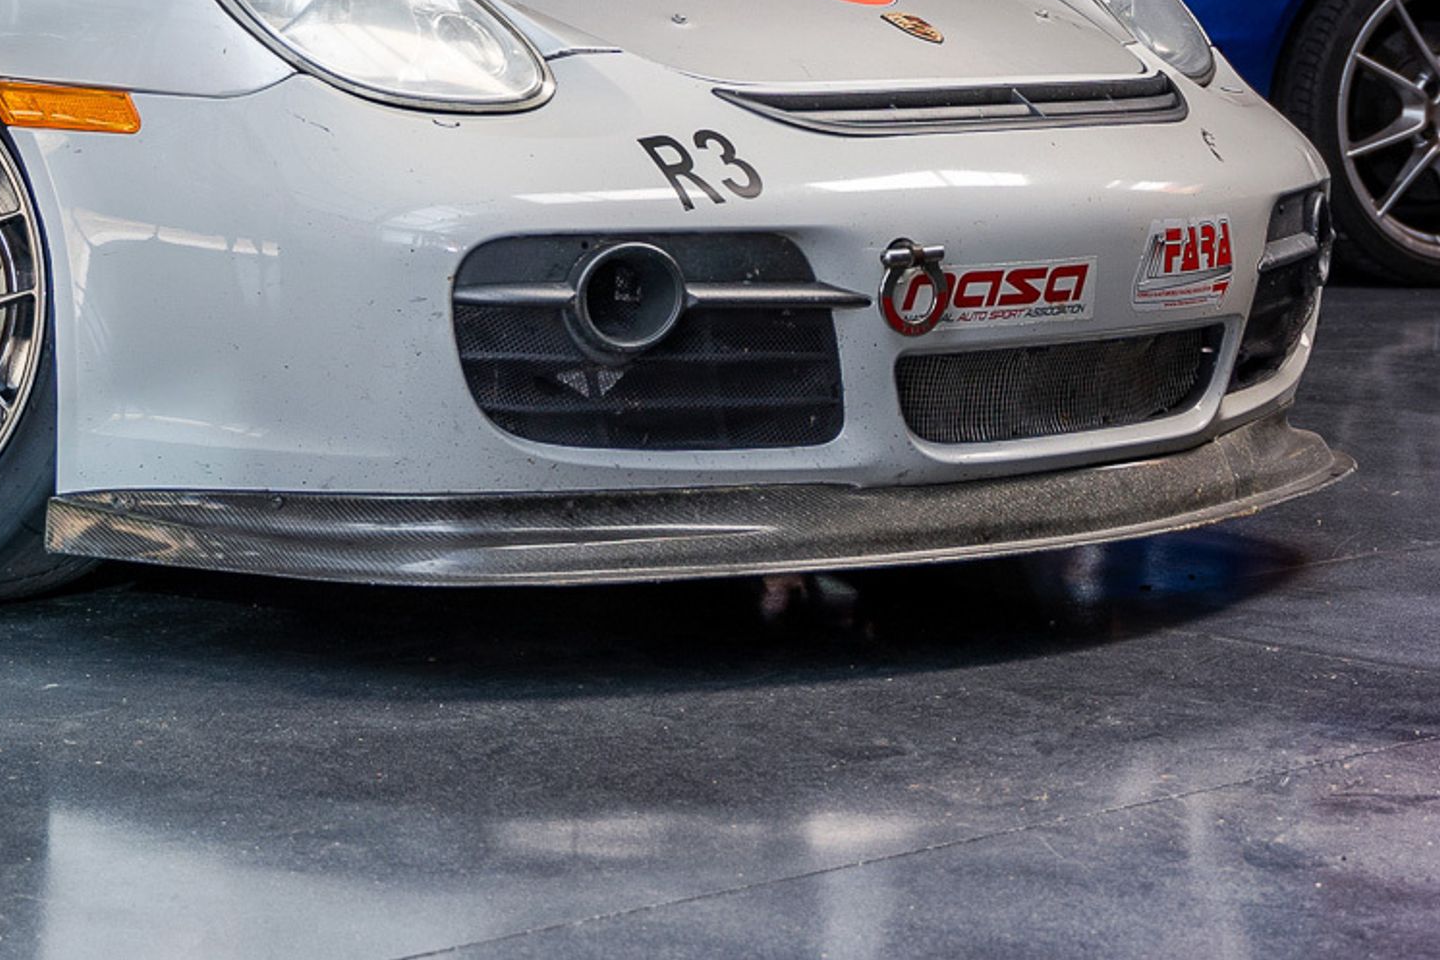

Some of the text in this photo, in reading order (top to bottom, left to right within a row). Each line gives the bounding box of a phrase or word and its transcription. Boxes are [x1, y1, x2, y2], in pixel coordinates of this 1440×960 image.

[637, 129, 763, 211] R3
[1164, 222, 1232, 273] FARA
[956, 310, 986, 322] AUTO
[988, 308, 1026, 320] SPORT
